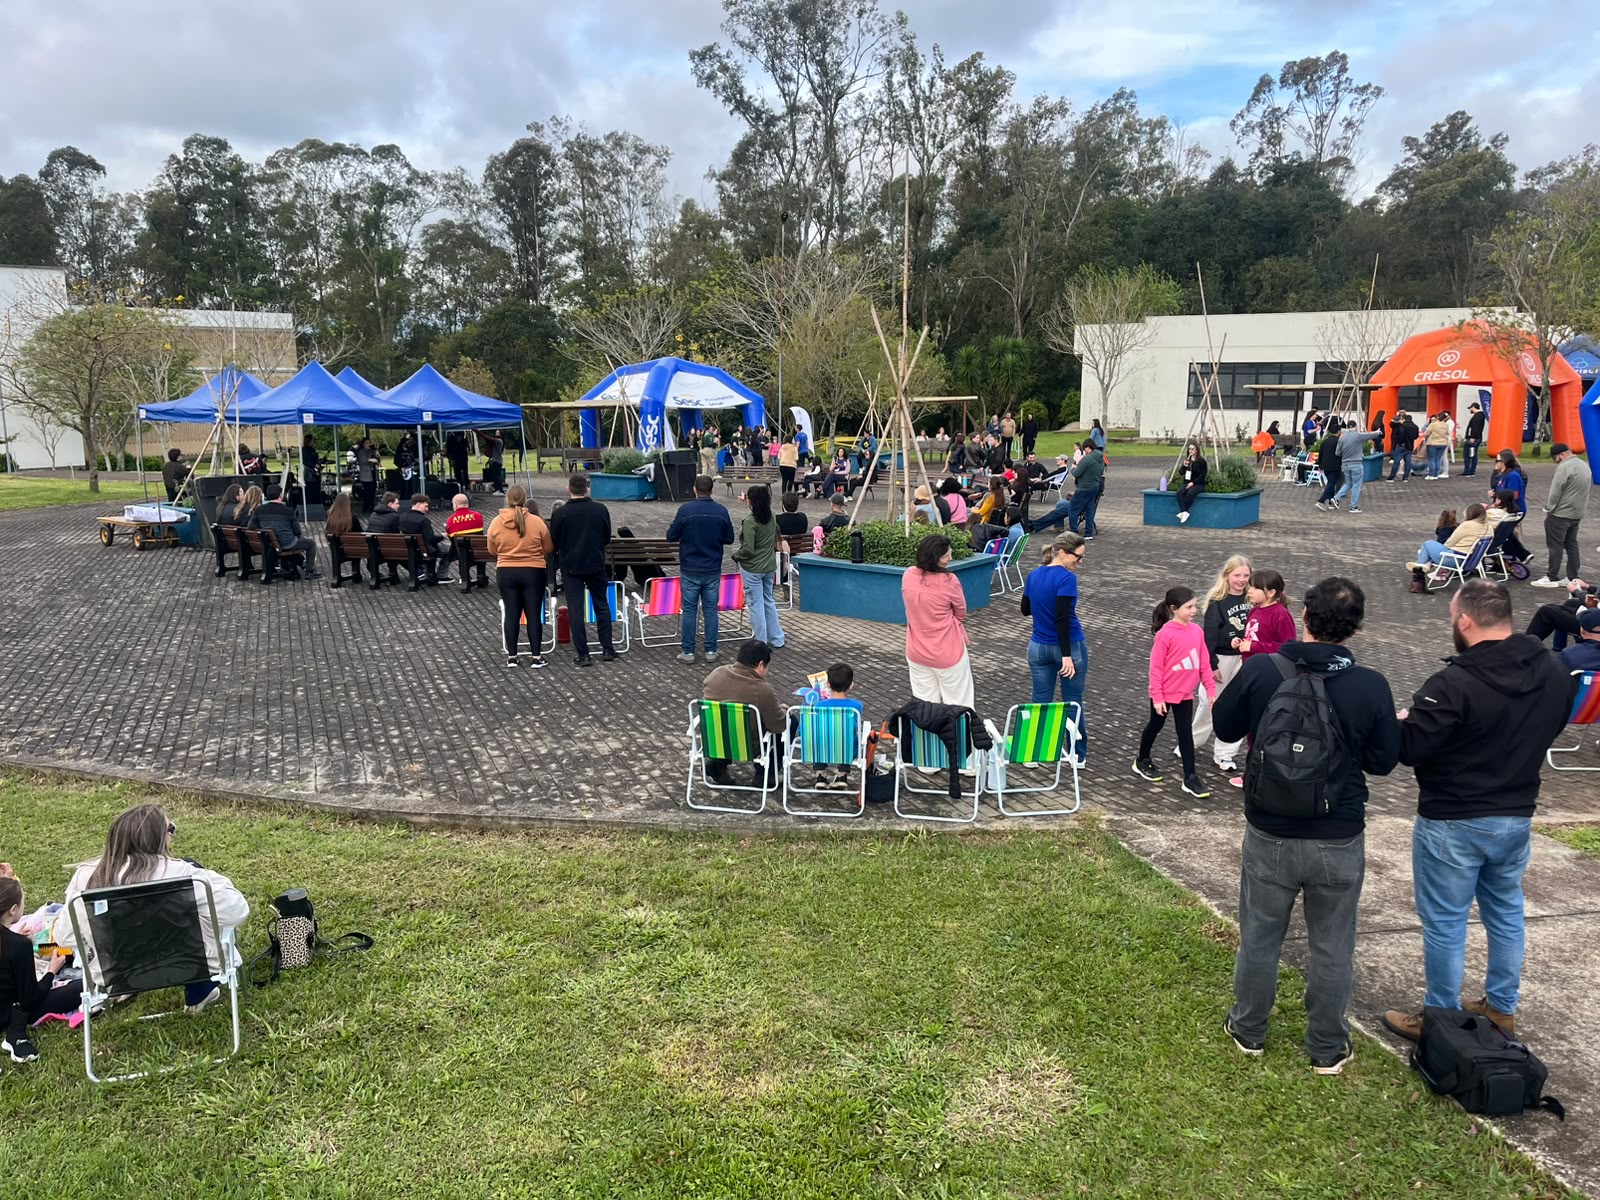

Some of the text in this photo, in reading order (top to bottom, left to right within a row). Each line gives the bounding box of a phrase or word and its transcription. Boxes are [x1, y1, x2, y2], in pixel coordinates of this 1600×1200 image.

[1414, 369, 1470, 383] CRESOL
[672, 396, 704, 407] Sesc
[1227, 604, 1240, 617] ROCK
